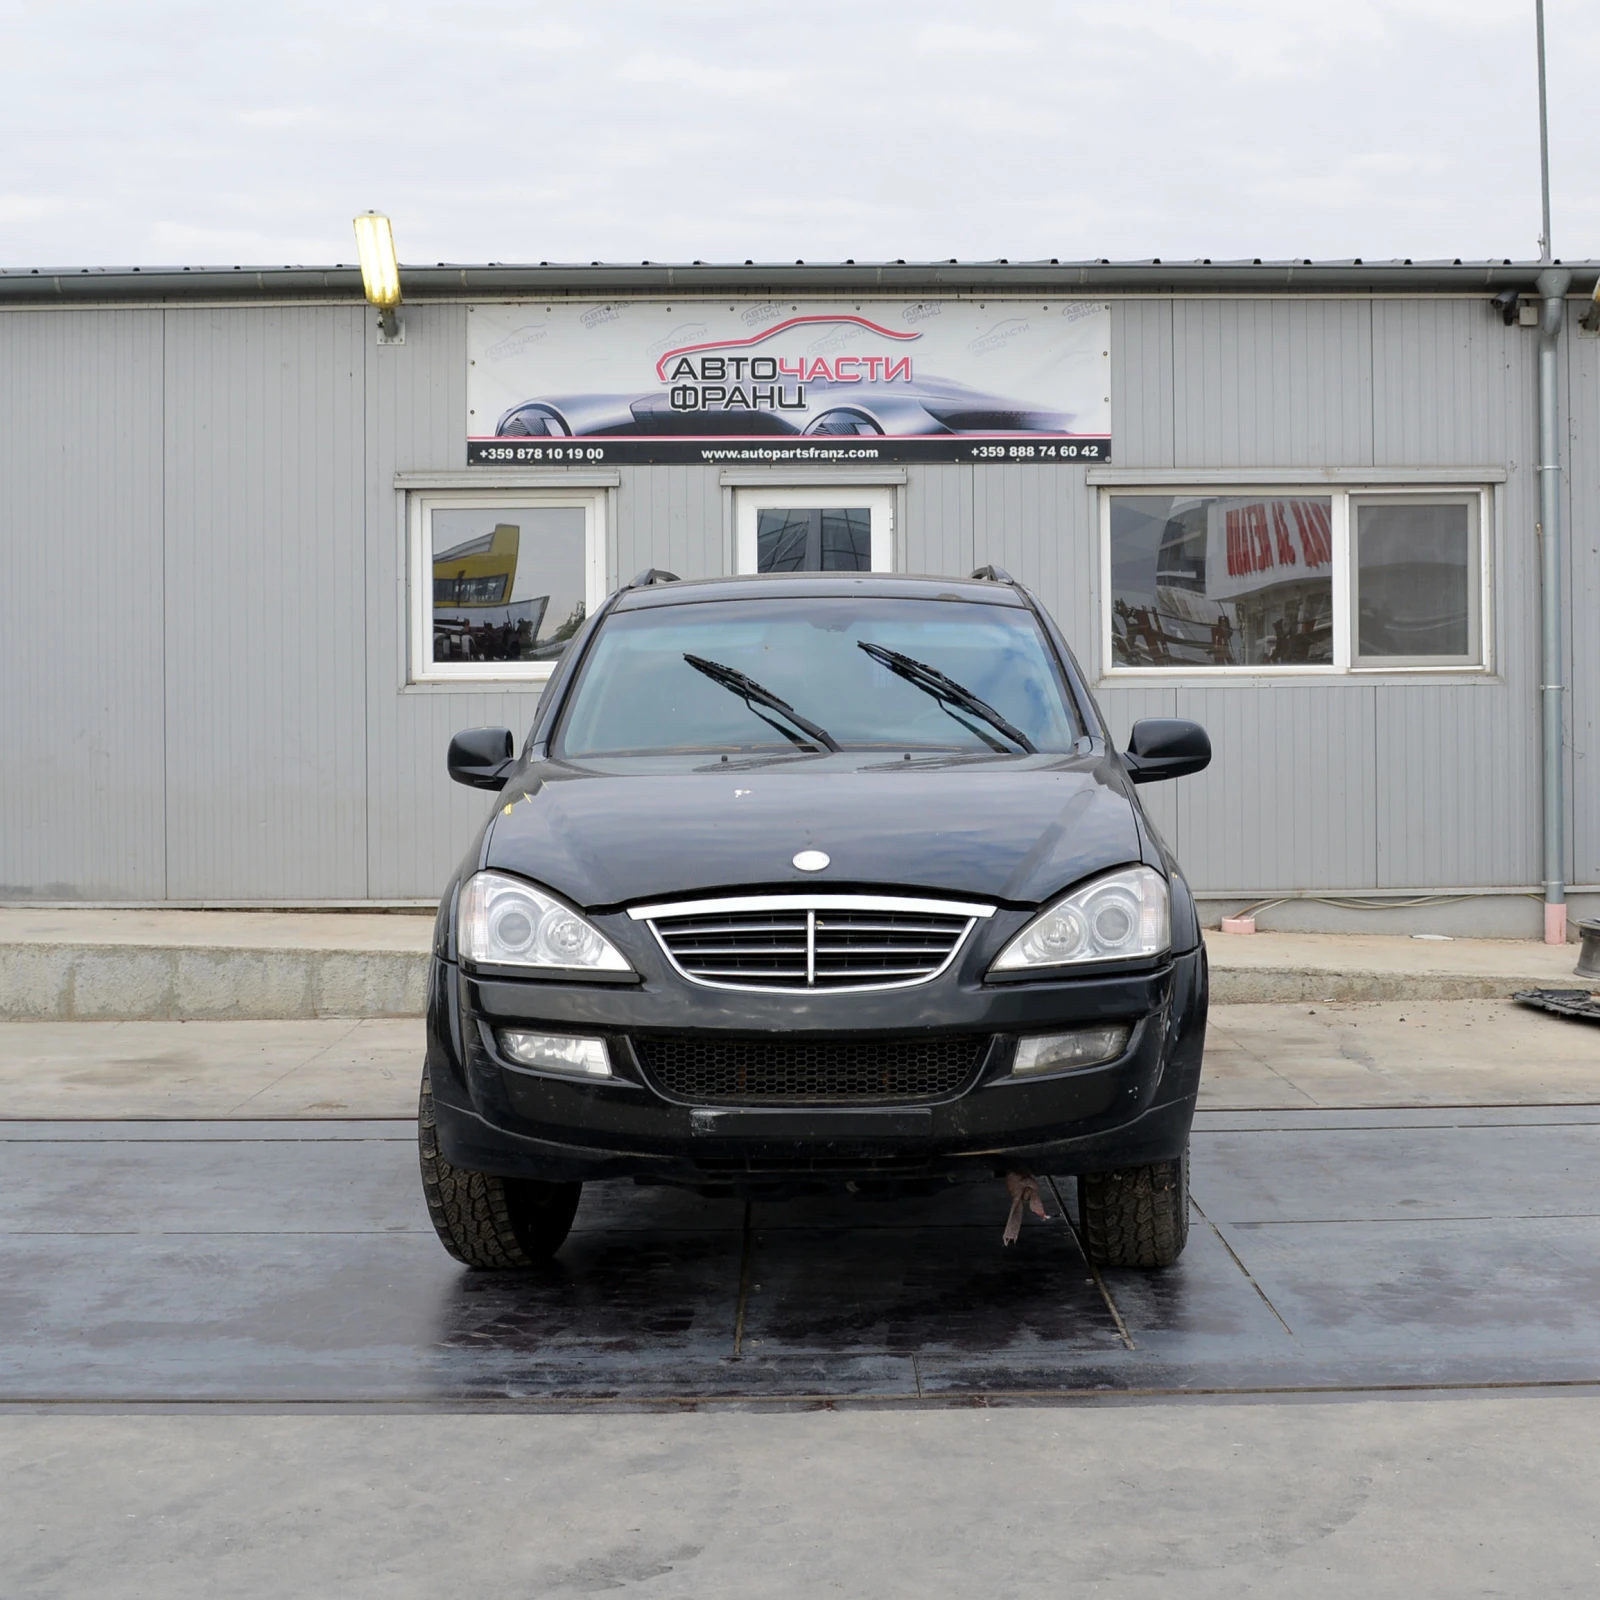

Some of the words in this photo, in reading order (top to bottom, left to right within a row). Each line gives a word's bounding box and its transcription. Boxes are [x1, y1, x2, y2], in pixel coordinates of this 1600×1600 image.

[670, 356, 912, 382] АВТОЧАСТИ
[670, 384, 807, 411] ФРАНЦ
[479, 448, 514, 459] +359
[517, 448, 542, 459] 878
[546, 448, 563, 459] 10
[567, 448, 584, 459] 19
[586, 448, 604, 459] 00
[701, 447, 879, 461] www.autopartsfranz.com
[971, 446, 1005, 457] +359
[1009, 446, 1035, 457] 888
[1039, 446, 1056, 457] 74
[1060, 446, 1077, 457] 60
[1081, 446, 1099, 457] 42
